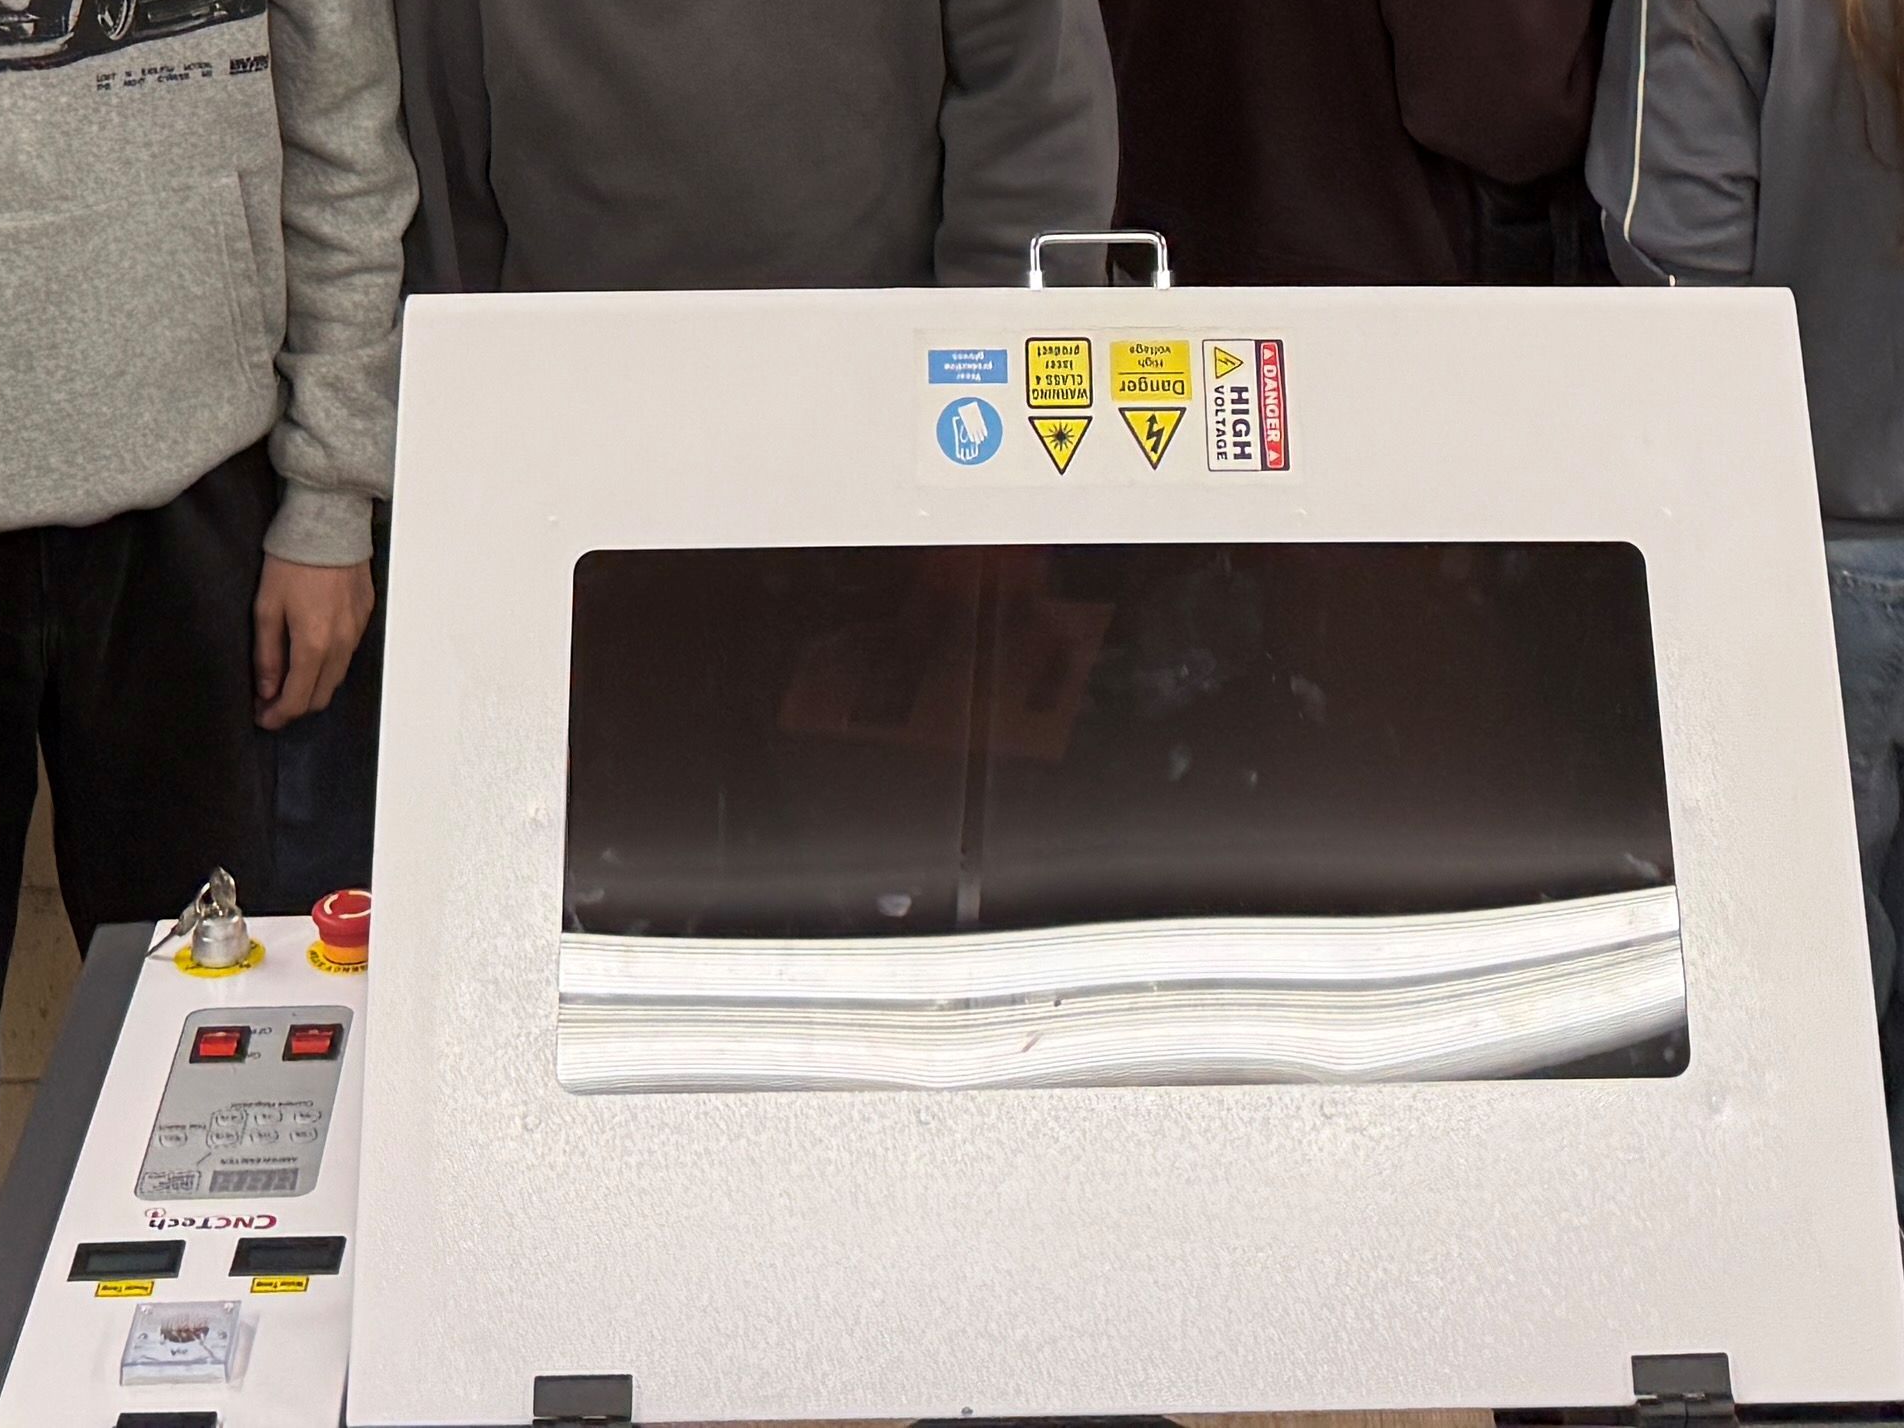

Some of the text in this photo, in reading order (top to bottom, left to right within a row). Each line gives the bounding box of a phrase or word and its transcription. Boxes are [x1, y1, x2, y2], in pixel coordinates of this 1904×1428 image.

[1036, 344, 1081, 357] product
[1128, 344, 1172, 356] voltage
[1138, 356, 1164, 369] High
[1035, 374, 1084, 386] CLASS 4
[1119, 376, 1185, 396] Danger
[1031, 387, 1089, 401] WARNING
[1263, 364, 1281, 442] DANGER
[1213, 385, 1228, 461] VOLTAGE
[1229, 385, 1253, 461] HIGH
[148, 1212, 278, 1230] CNCTech
